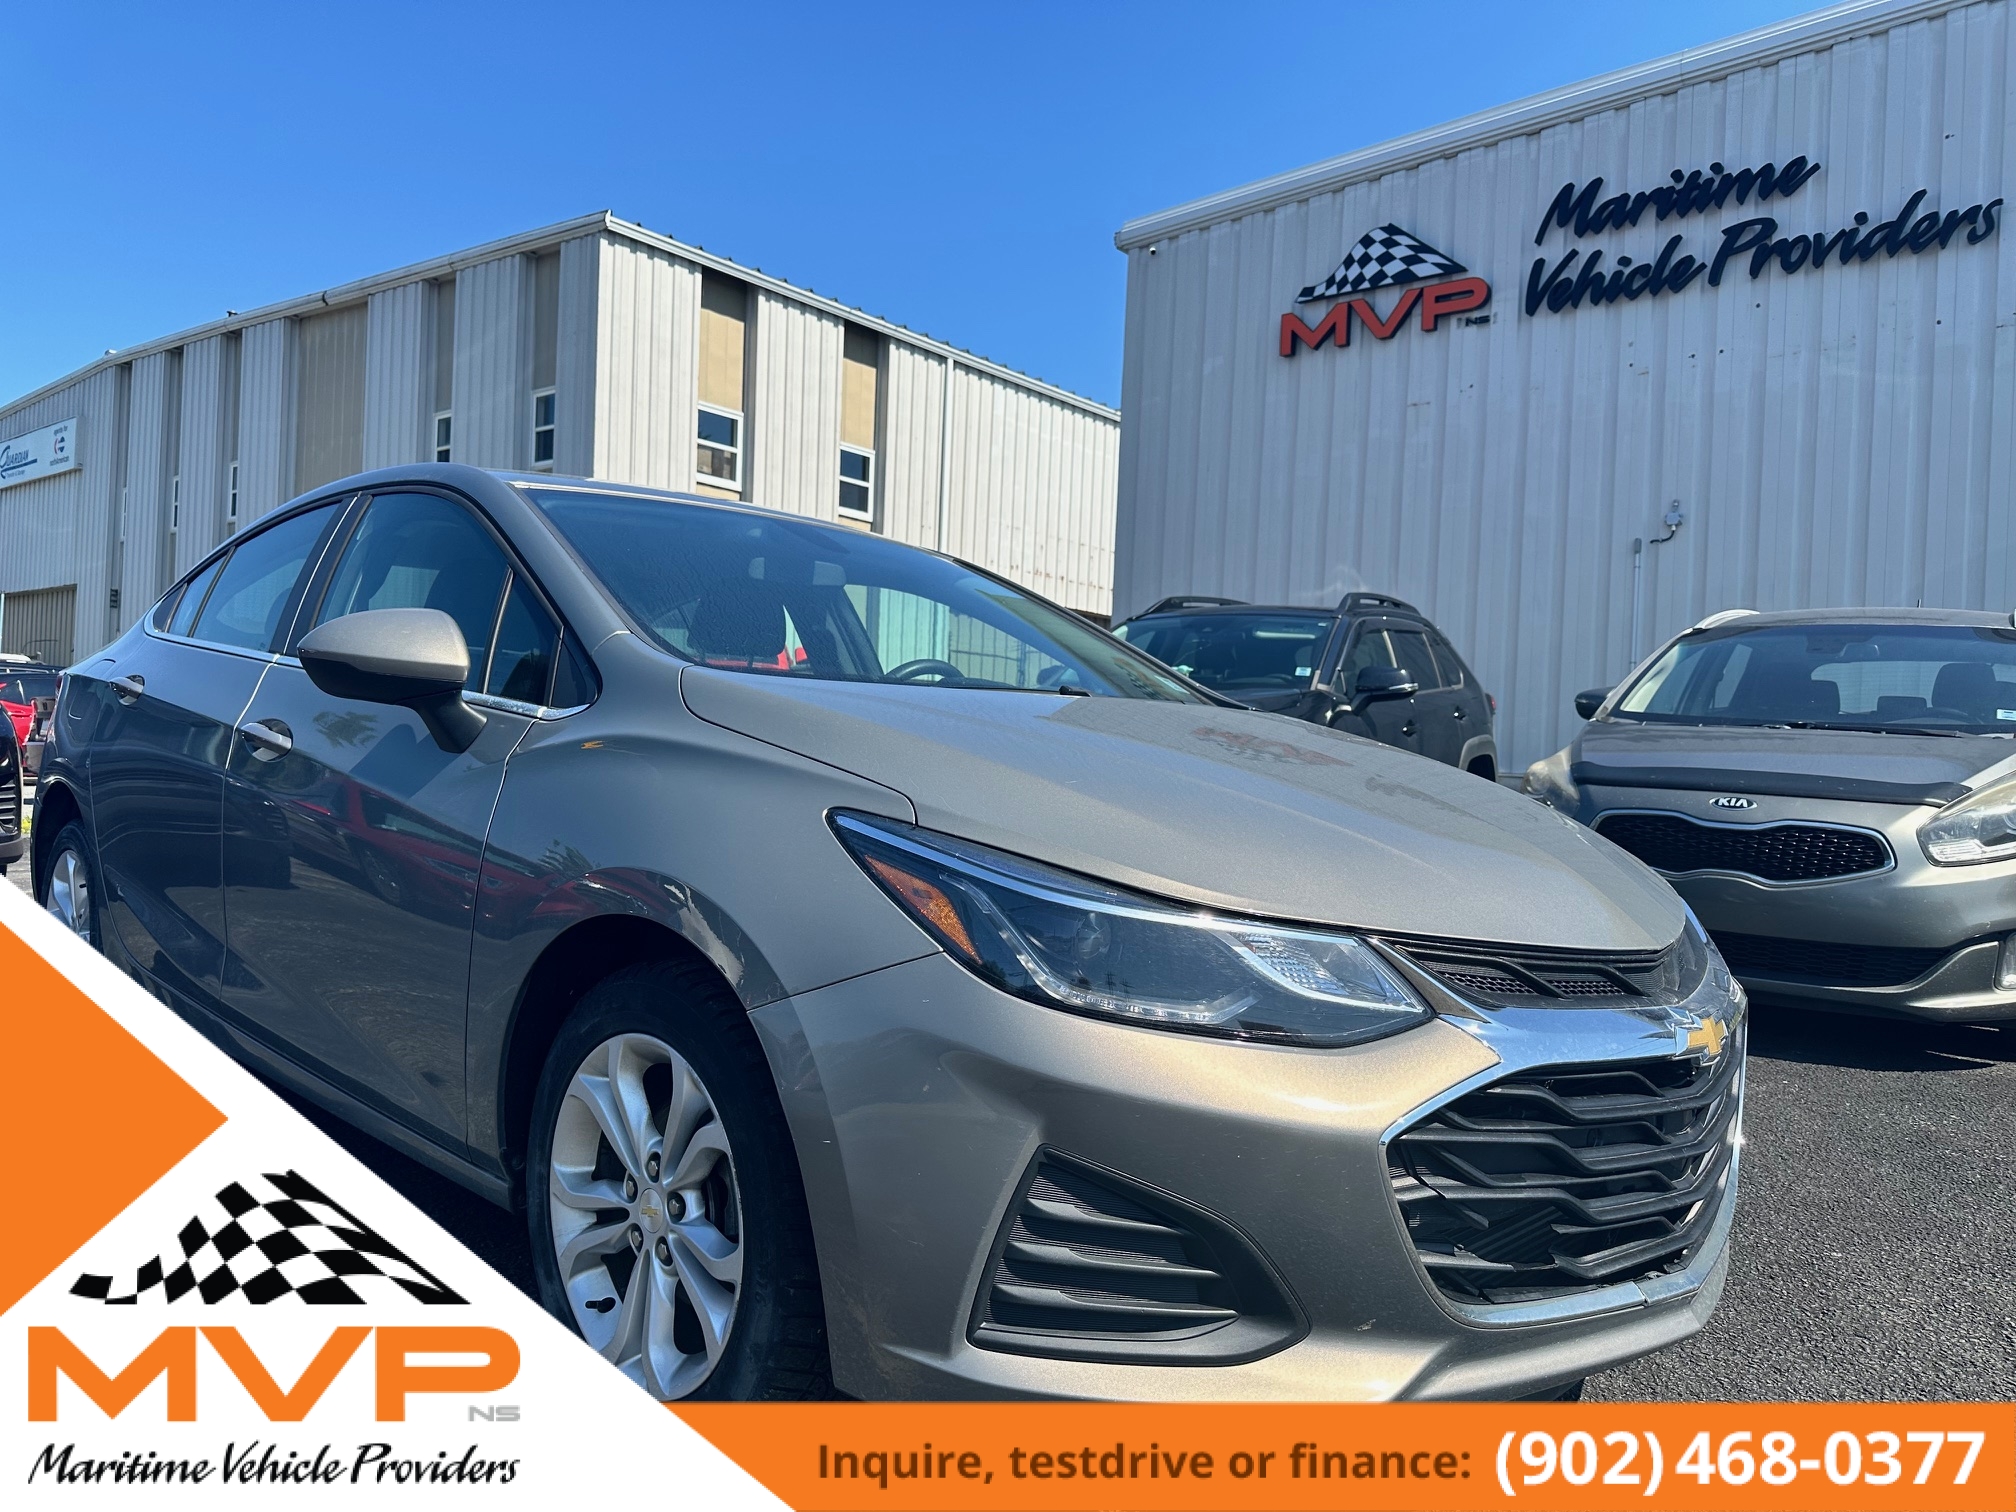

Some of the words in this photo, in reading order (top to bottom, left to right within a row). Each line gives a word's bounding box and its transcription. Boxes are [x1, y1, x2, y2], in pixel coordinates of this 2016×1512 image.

[1534, 155, 1821, 246] Maritime
[1525, 234, 1707, 317] Vehicle
[1708, 188, 2004, 287] Providers
[1279, 277, 1492, 357] MVP
[1465, 314, 1490, 328] NS
[1717, 797, 1748, 808] KIA
